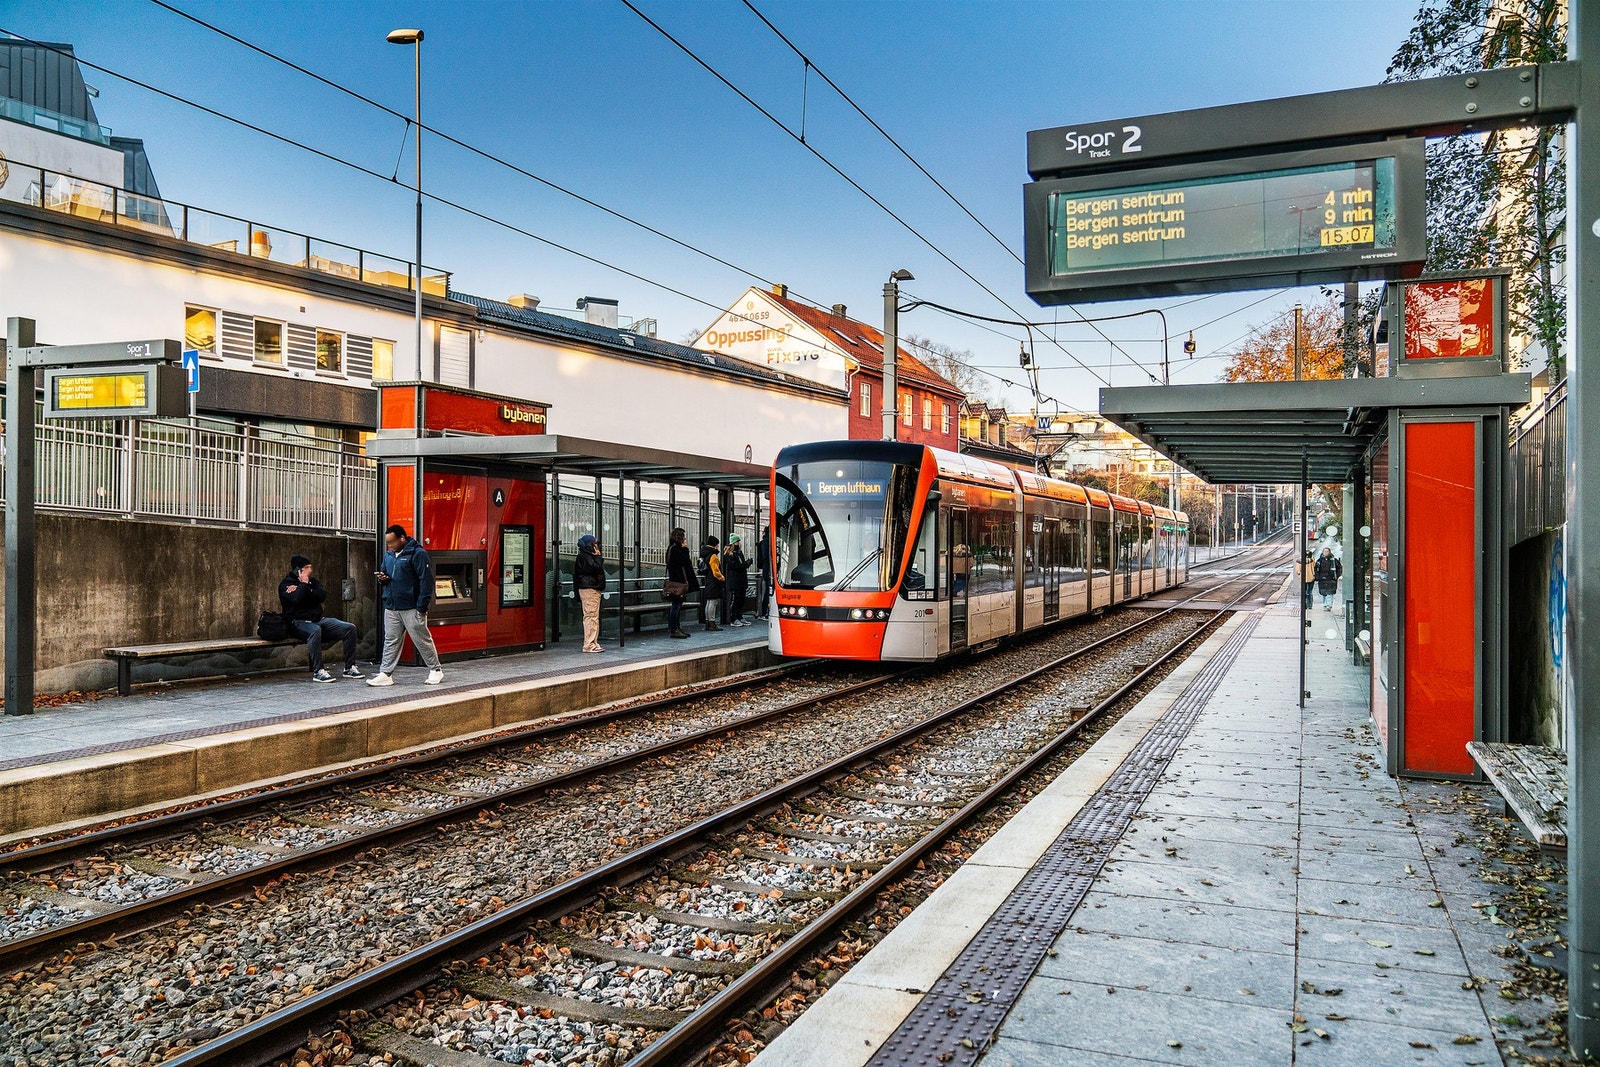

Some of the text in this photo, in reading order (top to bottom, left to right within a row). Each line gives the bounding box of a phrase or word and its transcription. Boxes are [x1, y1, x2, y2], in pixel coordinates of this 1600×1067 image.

[1065, 125, 1142, 154] Spor 2
[1088, 148, 1111, 158] Track
[1066, 191, 1185, 216] Bergen sentrum
[1066, 187, 1373, 233] Bergen sentrum 4 min
[1066, 205, 1373, 250] Bergen sentrum 9 min
[1323, 226, 1371, 245] 15:07
[1360, 252, 1398, 260] MITRON
[706, 323, 794, 348] Oppussing?
[126, 343, 152, 356] Spor 1
[503, 404, 546, 424] bybanen
[1039, 417, 1049, 428] W
[806, 482, 812, 495] 1
[818, 481, 847, 496] Bergen
[495, 490, 503, 503] A
[1293, 522, 1301, 532] E
[914, 609, 925, 618] 201
